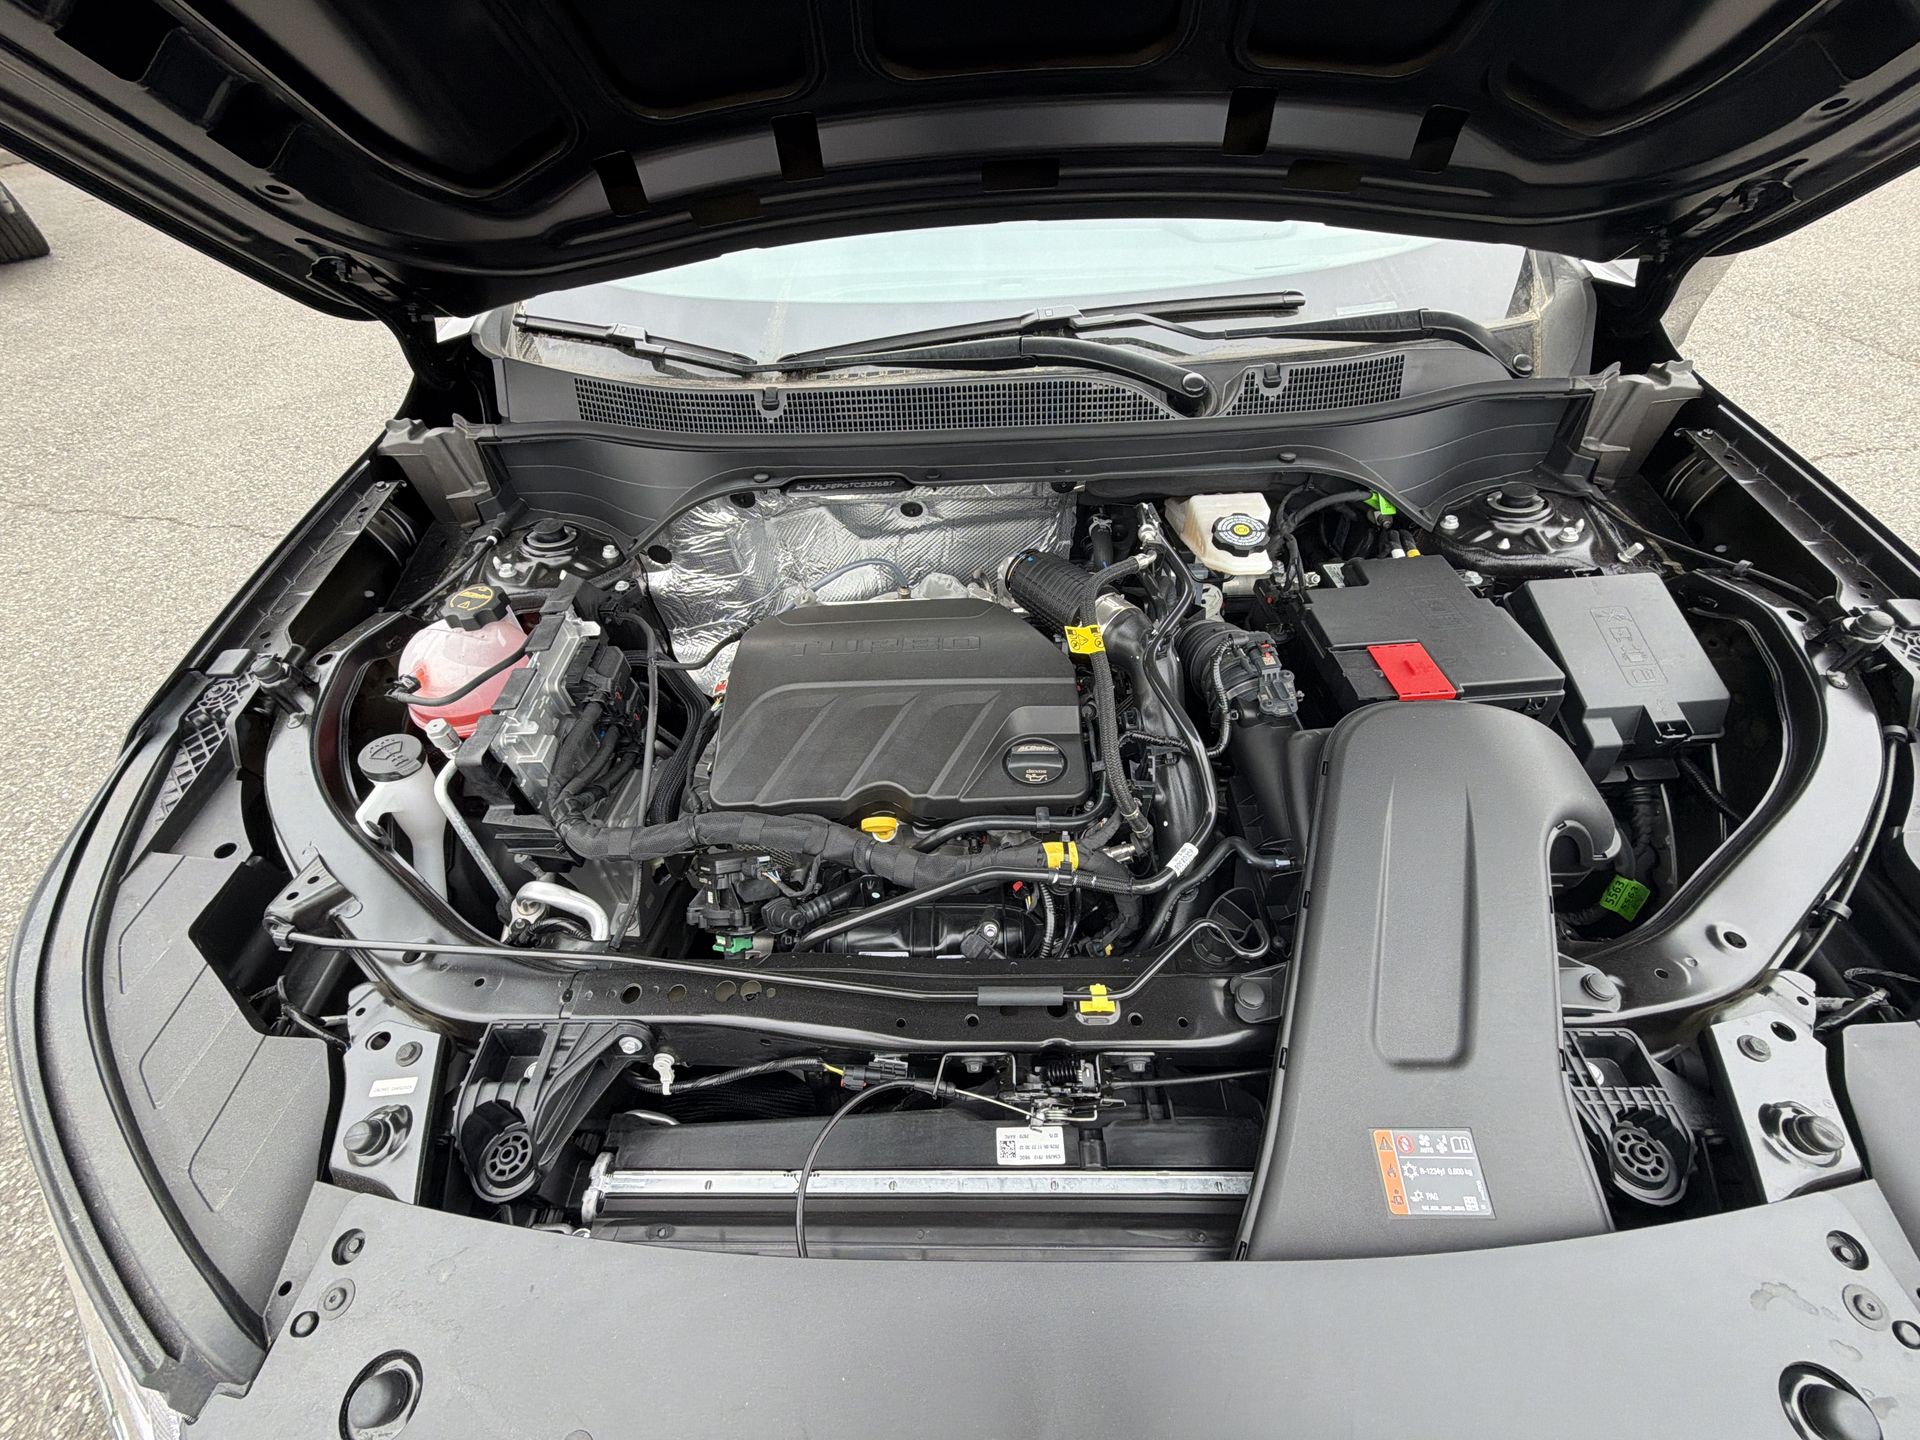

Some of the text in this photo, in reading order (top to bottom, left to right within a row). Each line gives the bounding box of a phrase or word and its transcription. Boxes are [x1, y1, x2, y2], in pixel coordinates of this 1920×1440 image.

[789, 633, 981, 656] TURBO
[1017, 745, 1055, 753] ACDelco
[1605, 880, 1625, 905] 5563
[1426, 1193, 1439, 1201] PAG
